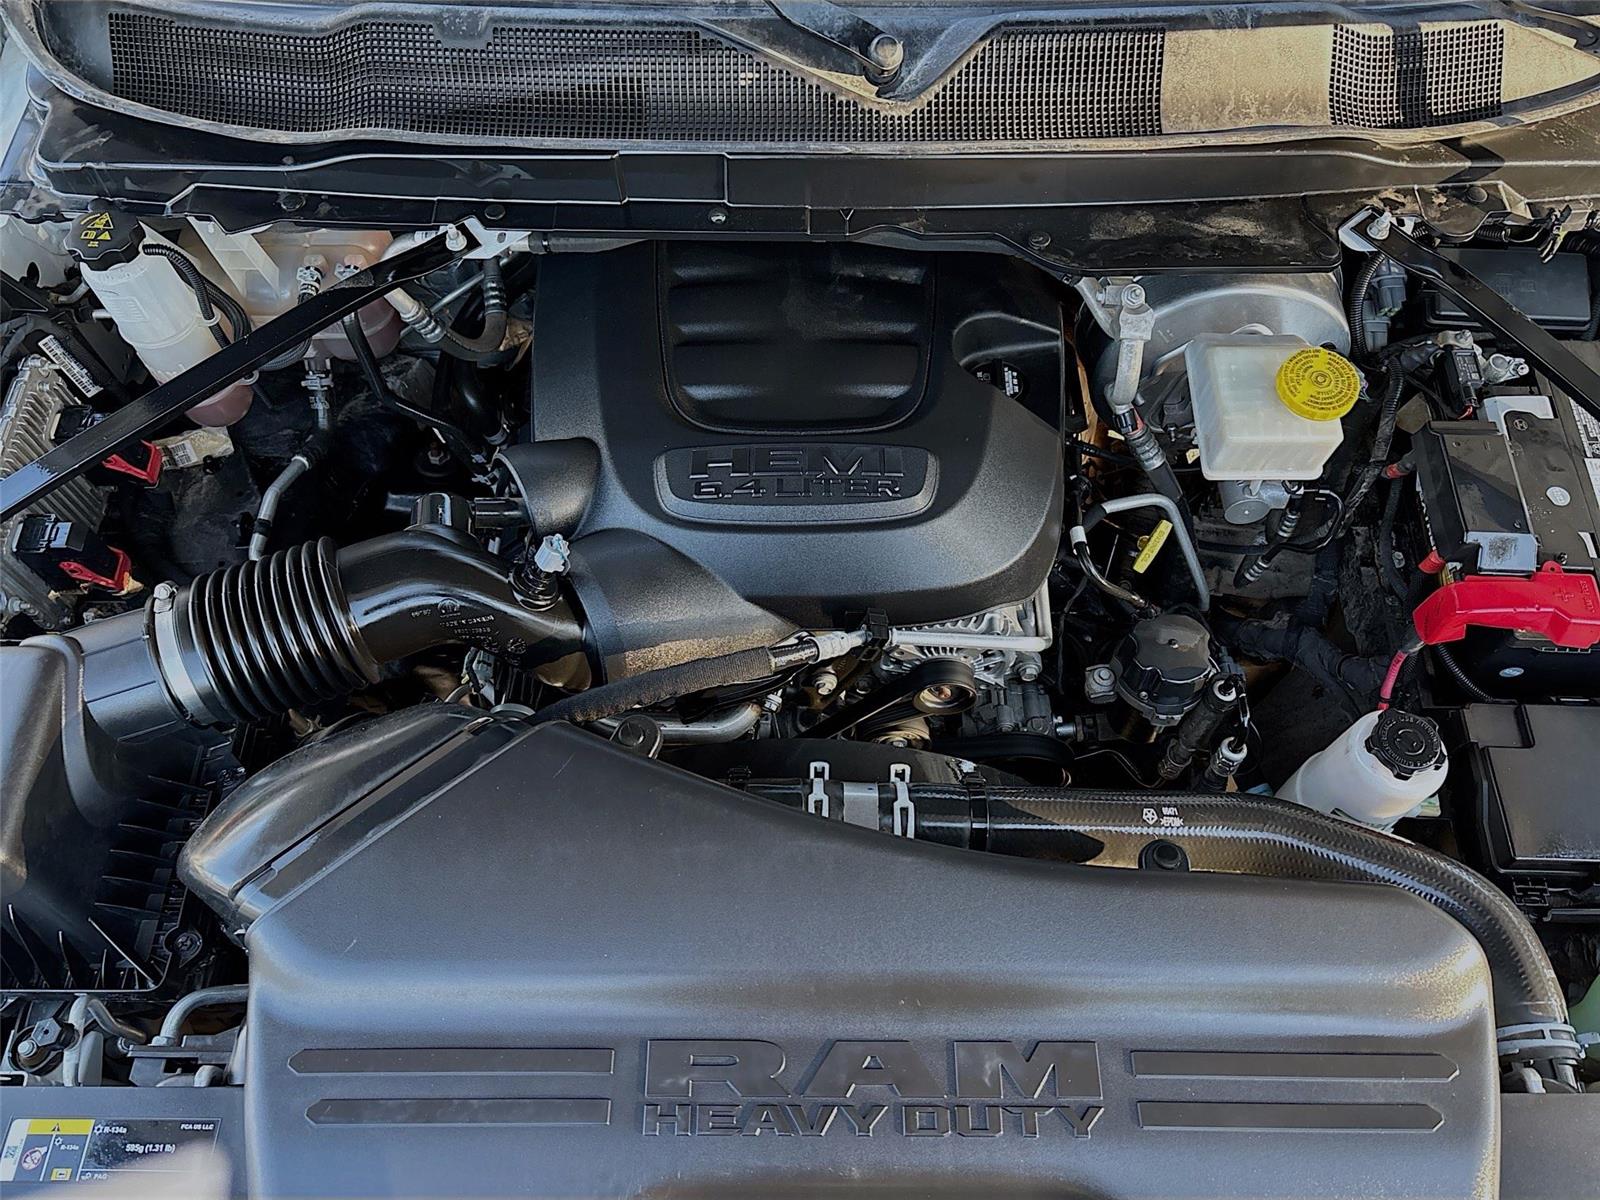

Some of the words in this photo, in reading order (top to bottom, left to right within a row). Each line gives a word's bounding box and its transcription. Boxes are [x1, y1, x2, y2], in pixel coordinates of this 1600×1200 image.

[689, 448, 904, 478] HEMI
[692, 481, 767, 498] 6.4
[775, 479, 902, 498] LITER
[644, 1038, 1103, 1099] RAM
[103, 1125, 128, 1134] R-134a
[643, 1104, 888, 1137] HEAVY
[902, 1104, 1104, 1139] DUTY
